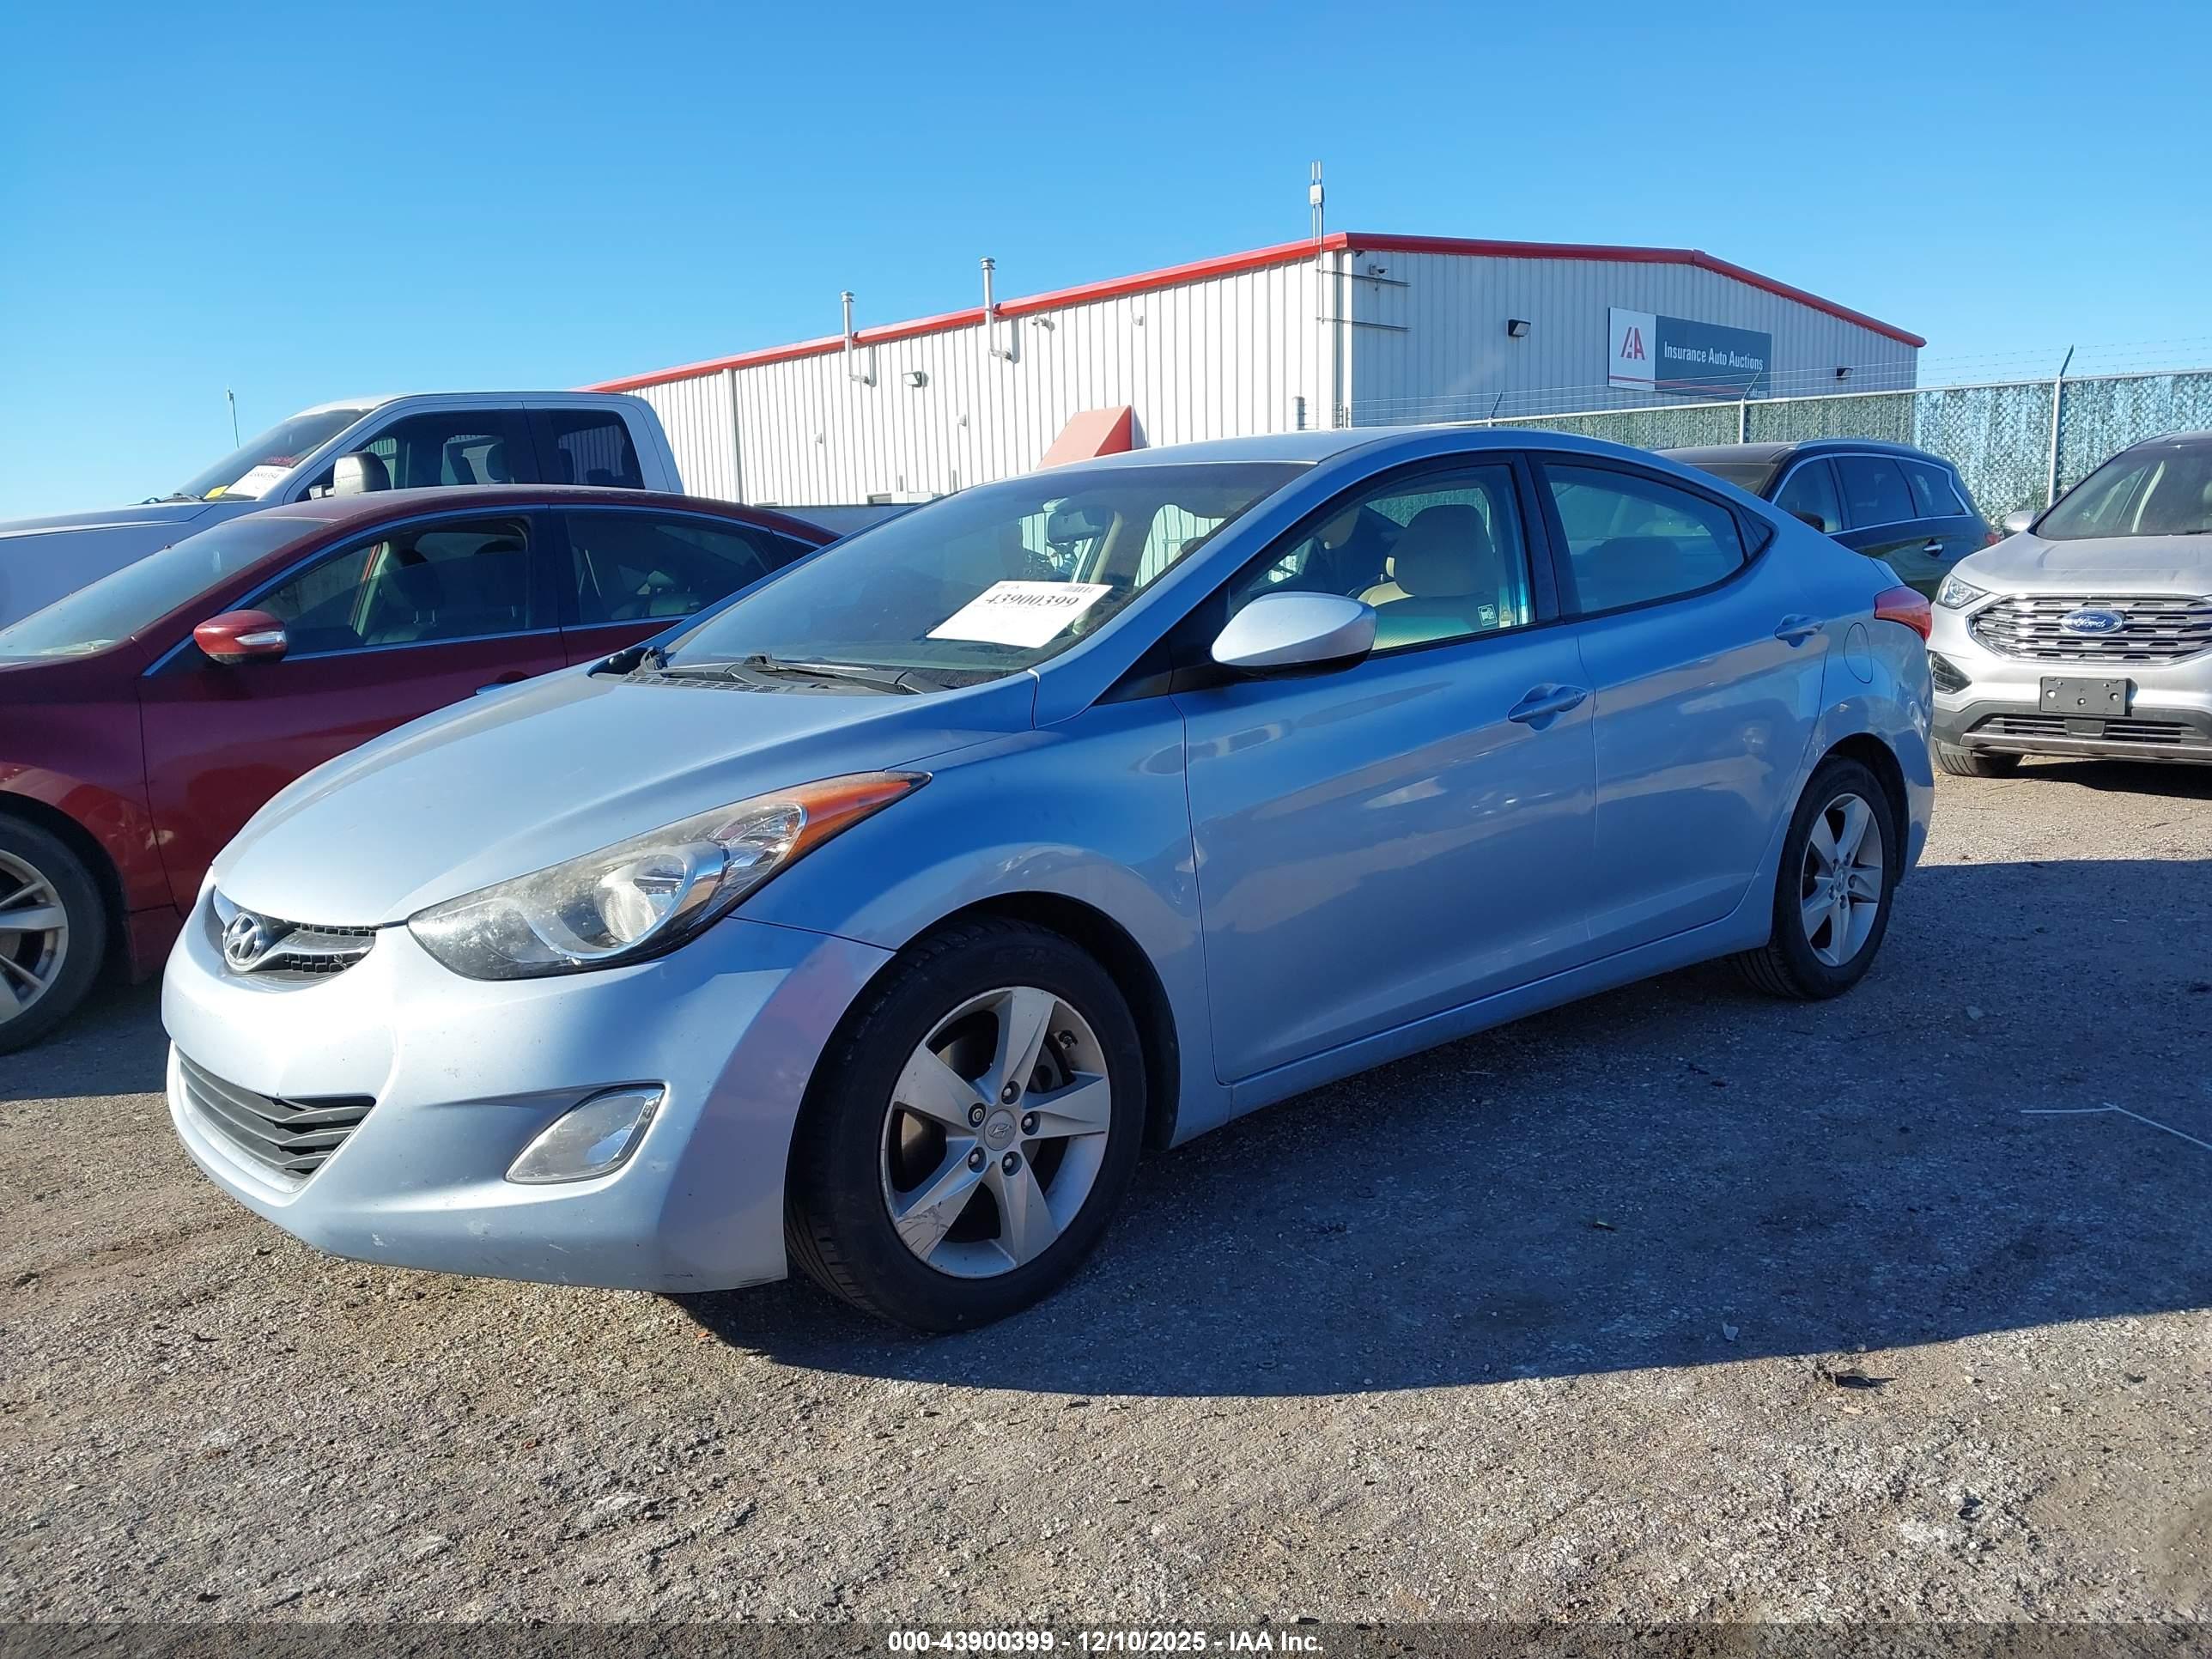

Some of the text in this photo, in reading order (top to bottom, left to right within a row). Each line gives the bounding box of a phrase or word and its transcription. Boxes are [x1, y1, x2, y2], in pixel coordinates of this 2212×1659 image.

[1664, 340, 1764, 371] Insurance Auto Auctions
[985, 593, 1079, 607] 43900399
[2074, 614, 2107, 628] Ford
